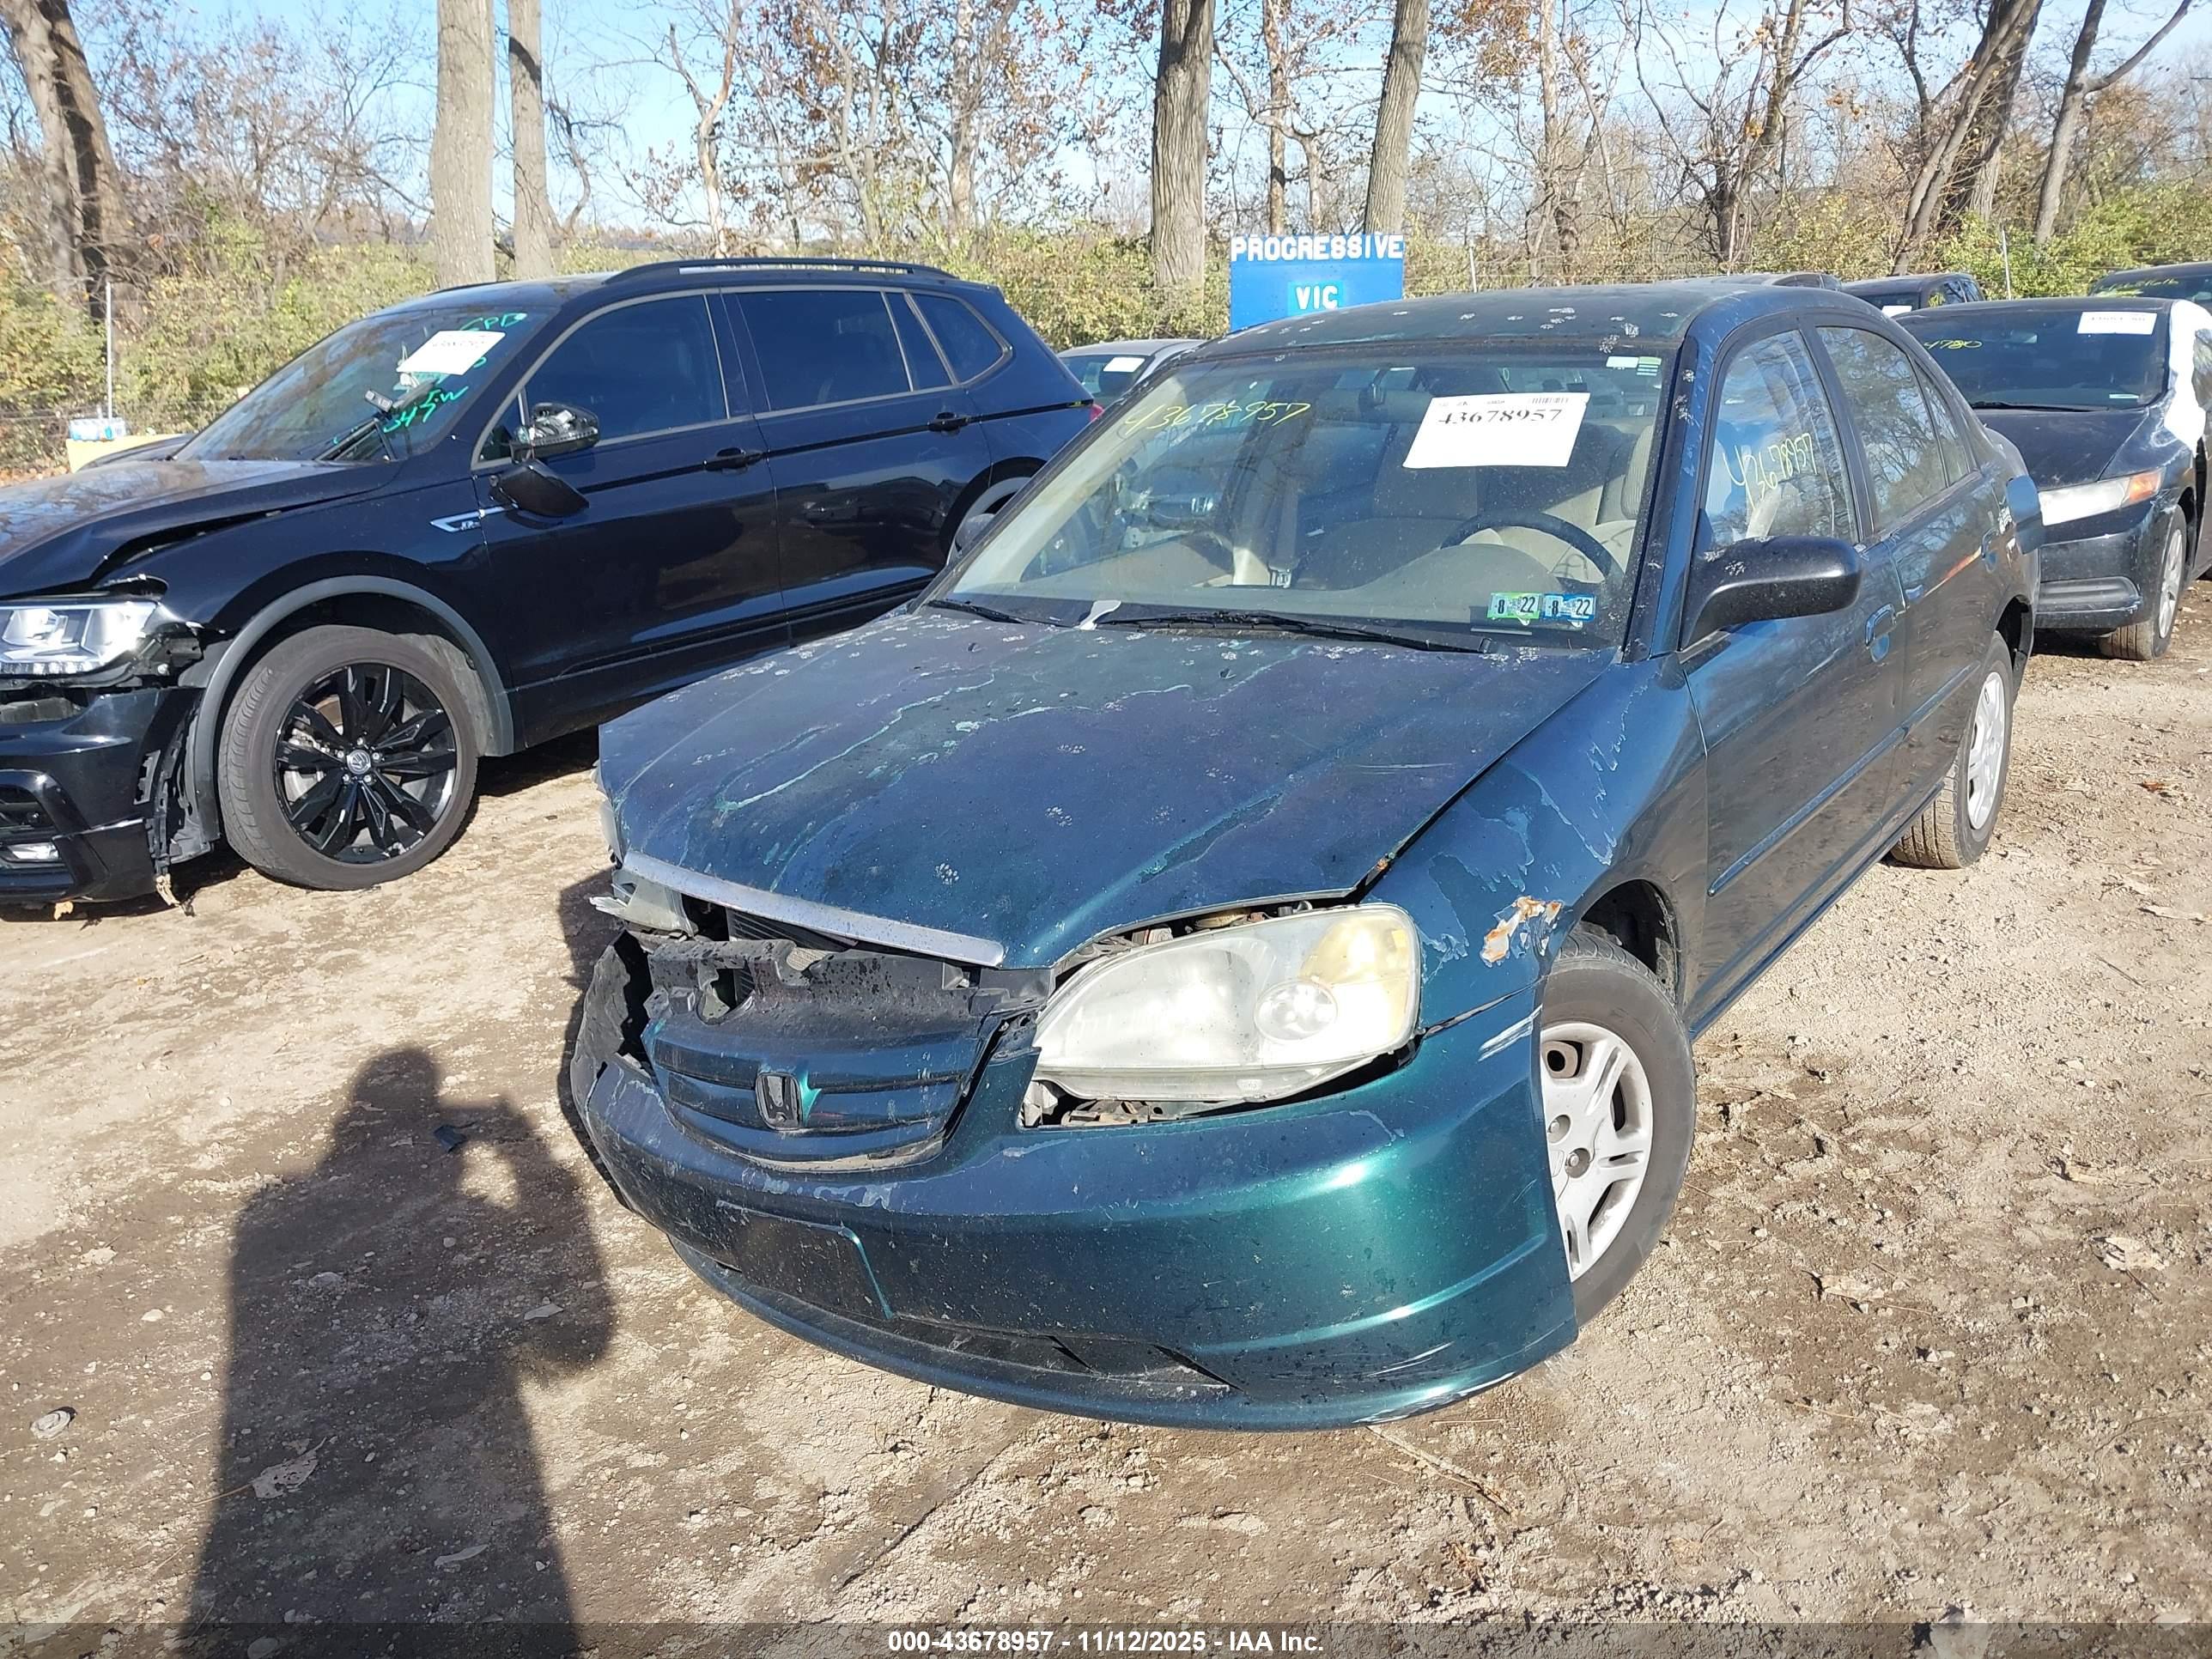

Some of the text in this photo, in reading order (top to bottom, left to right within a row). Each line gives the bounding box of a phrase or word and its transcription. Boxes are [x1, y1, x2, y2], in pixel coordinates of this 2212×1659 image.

[1231, 234, 1404, 261] PROGRESSIVE
[1296, 285, 1339, 310] VIC
[1125, 400, 1311, 435] 43678957
[1438, 409, 1563, 424] 43678957
[1521, 597, 1535, 612] 22
[1576, 599, 1590, 616] 22
